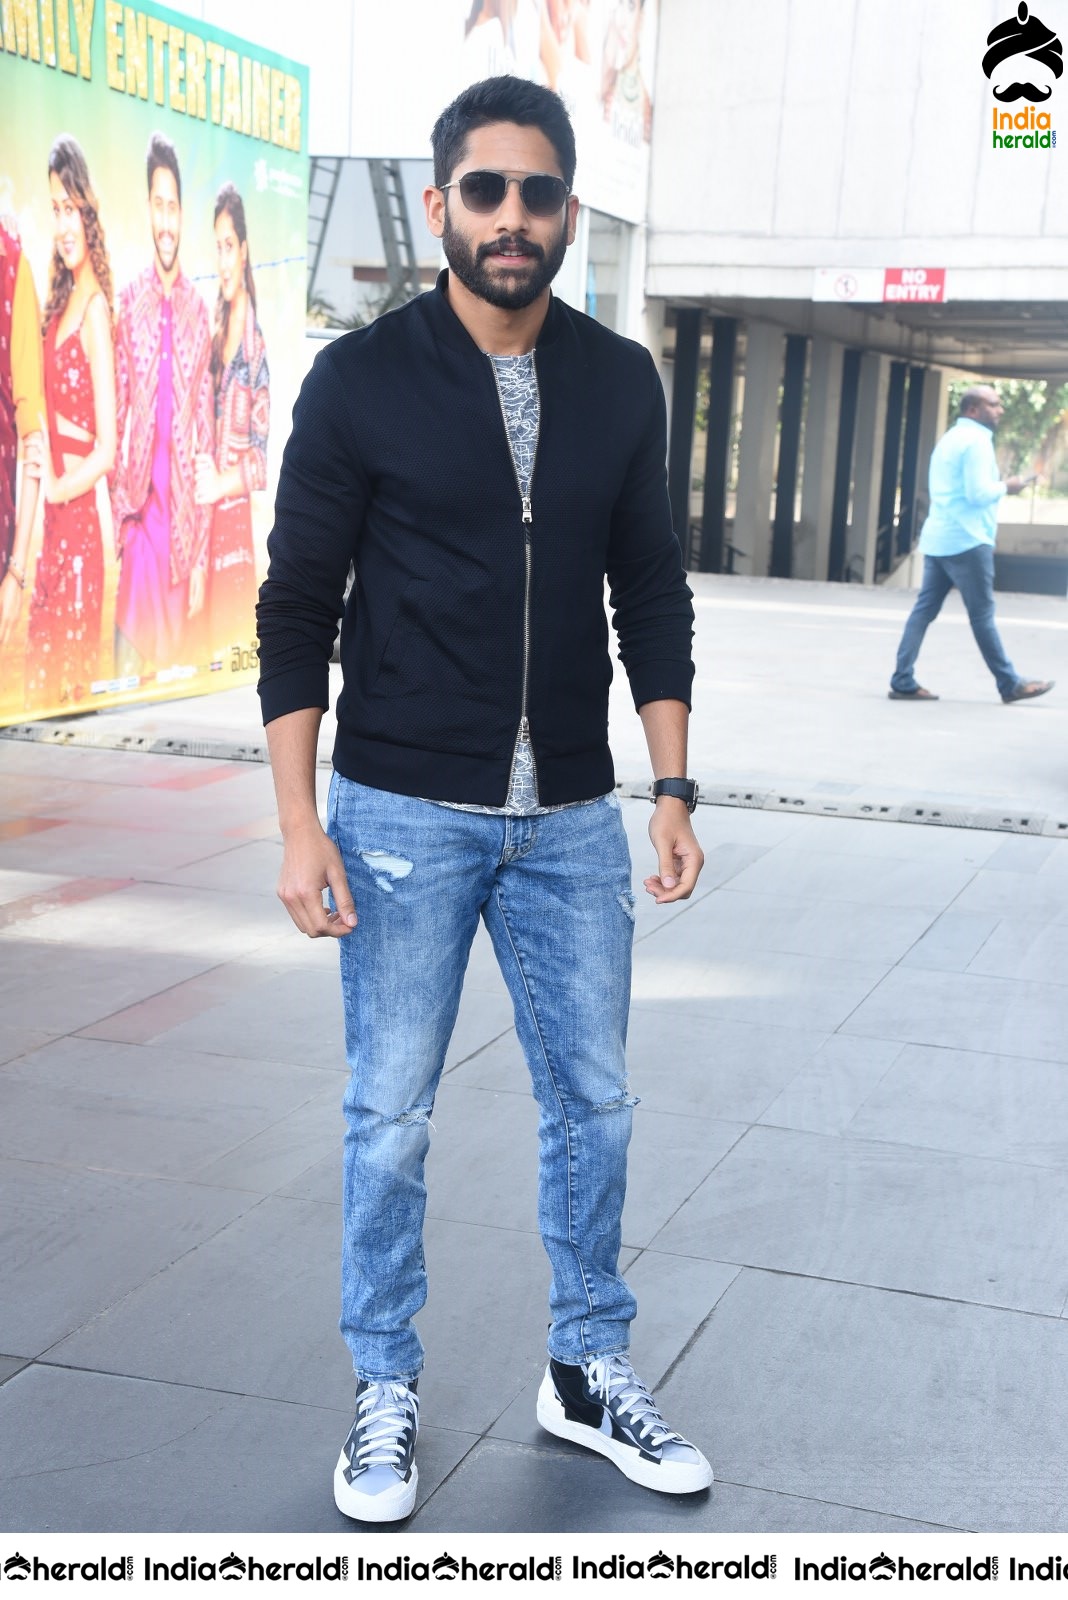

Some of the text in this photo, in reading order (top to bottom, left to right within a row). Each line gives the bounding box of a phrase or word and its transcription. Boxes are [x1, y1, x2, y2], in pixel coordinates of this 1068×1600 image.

[0, 0, 301, 154] MILY ENTERTAINER
[902, 269, 927, 284] NO
[885, 284, 941, 300] ENTRY
